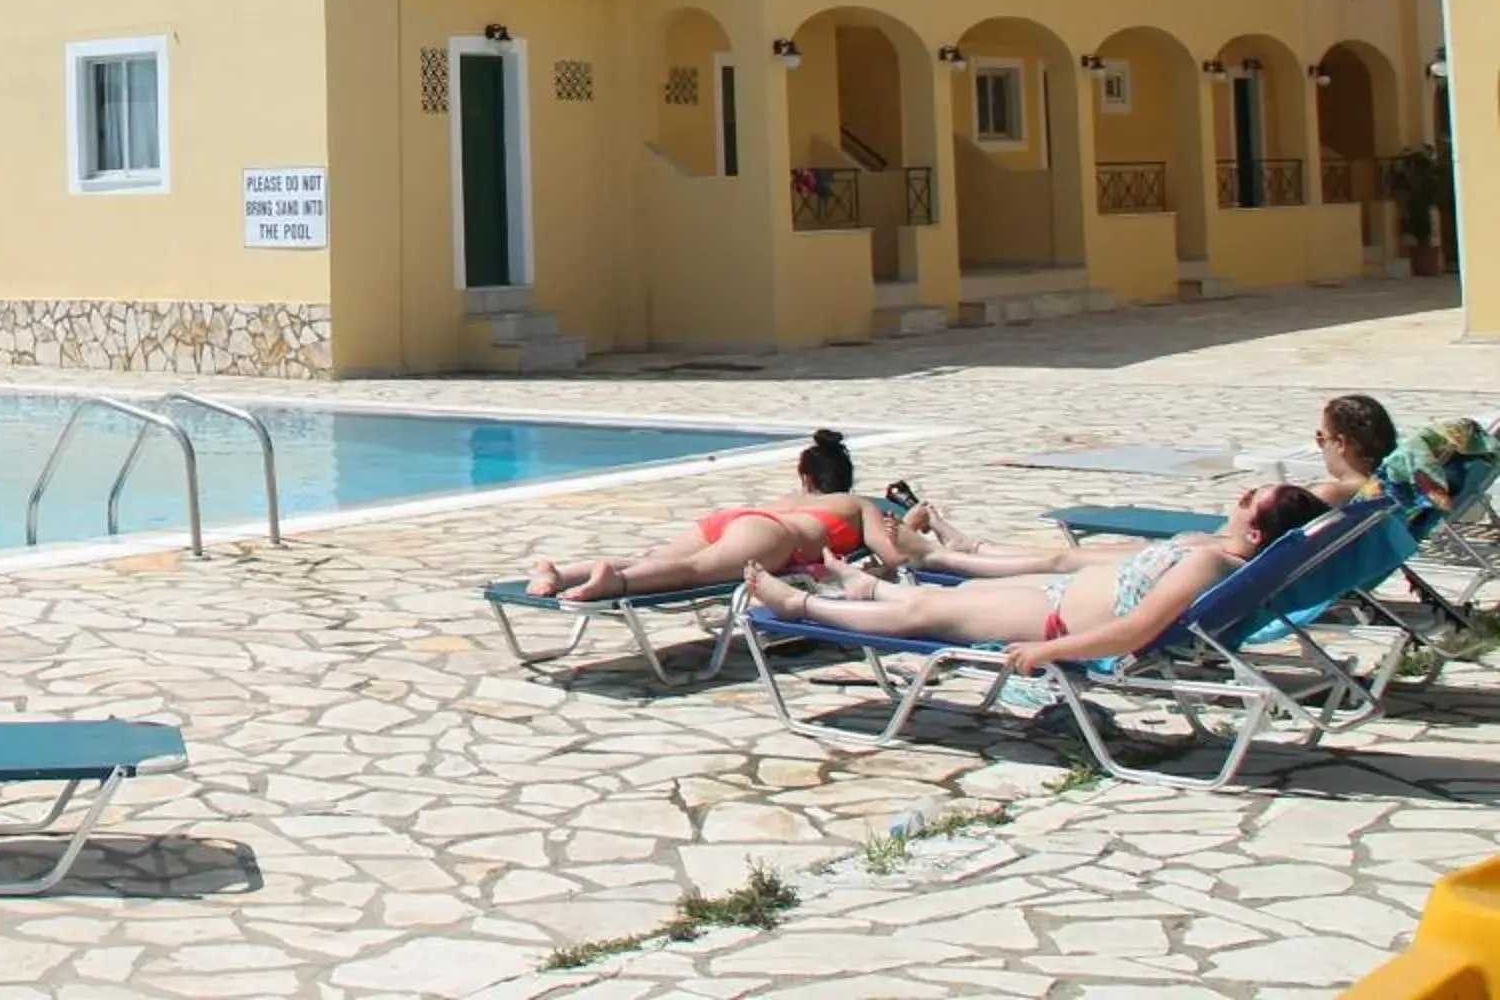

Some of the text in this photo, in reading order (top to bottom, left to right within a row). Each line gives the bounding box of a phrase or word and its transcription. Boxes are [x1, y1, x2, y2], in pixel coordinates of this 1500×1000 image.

[247, 174, 322, 192] PLEASE DO NOT
[246, 200, 273, 216] BRING
[275, 199, 299, 216] SAND
[260, 223, 312, 240] THE POOL
